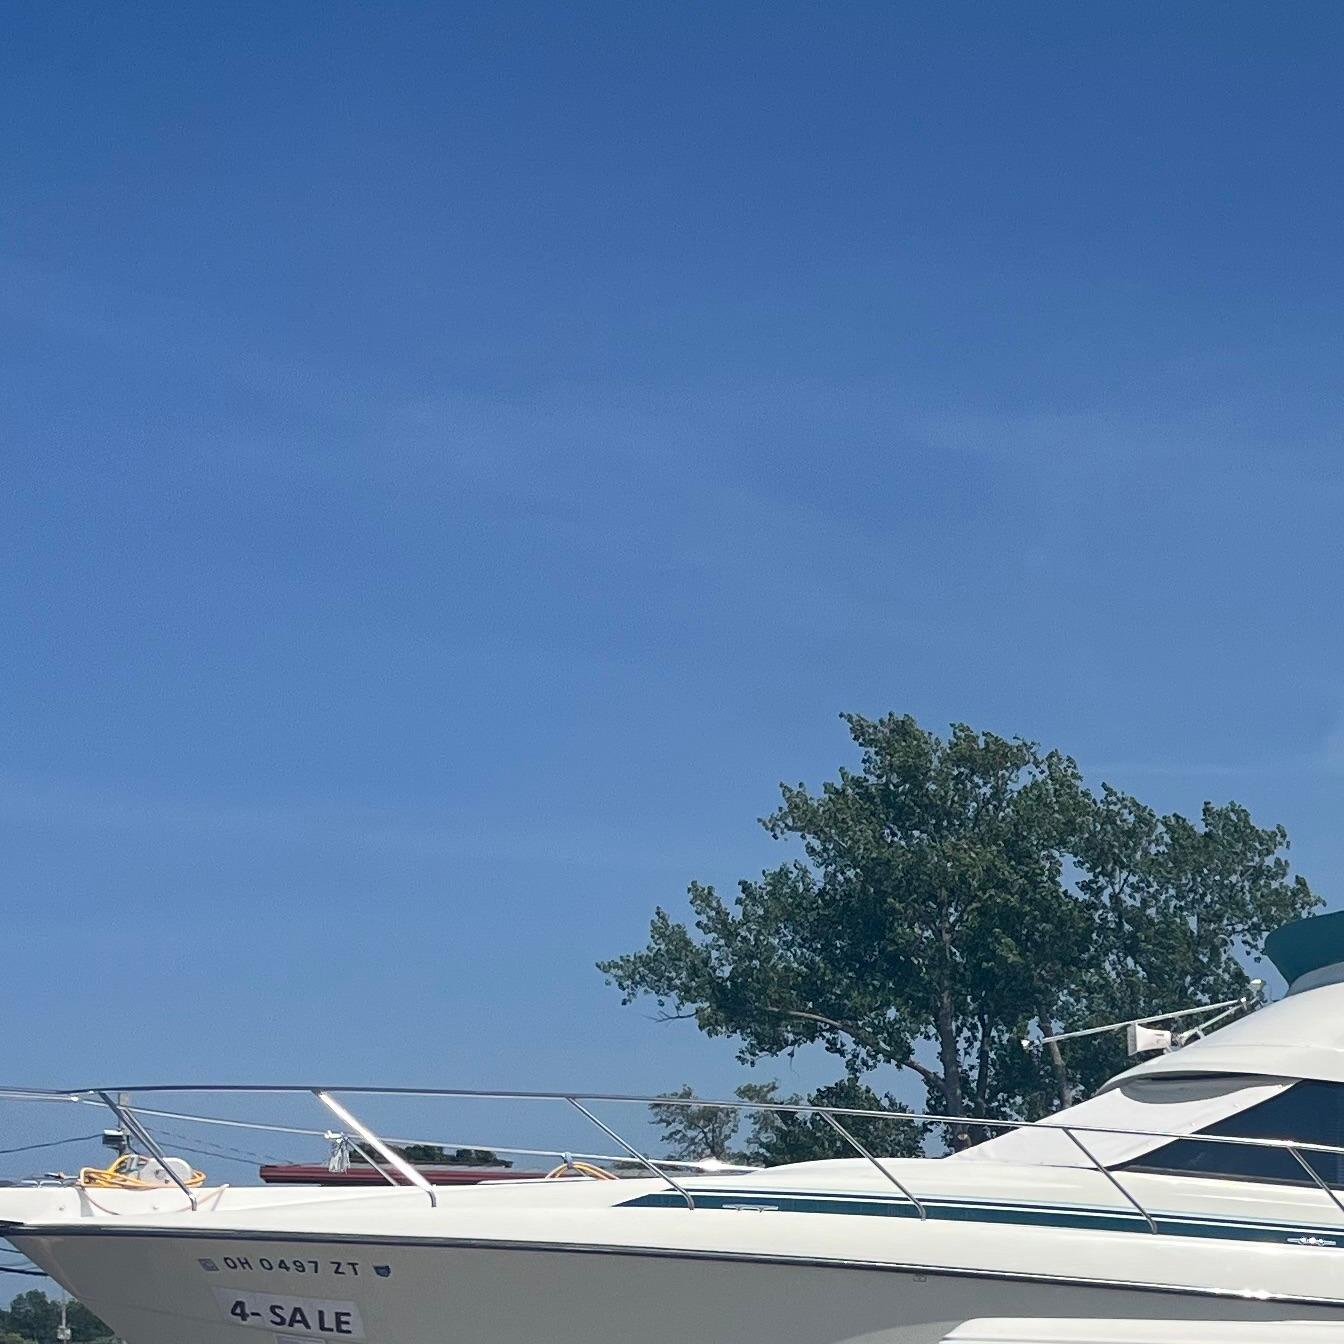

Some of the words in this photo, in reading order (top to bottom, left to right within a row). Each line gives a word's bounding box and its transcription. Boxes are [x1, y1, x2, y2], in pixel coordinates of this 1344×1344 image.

[223, 1256, 253, 1271] OH
[259, 1258, 320, 1274] 0497
[330, 1261, 360, 1276] ZT
